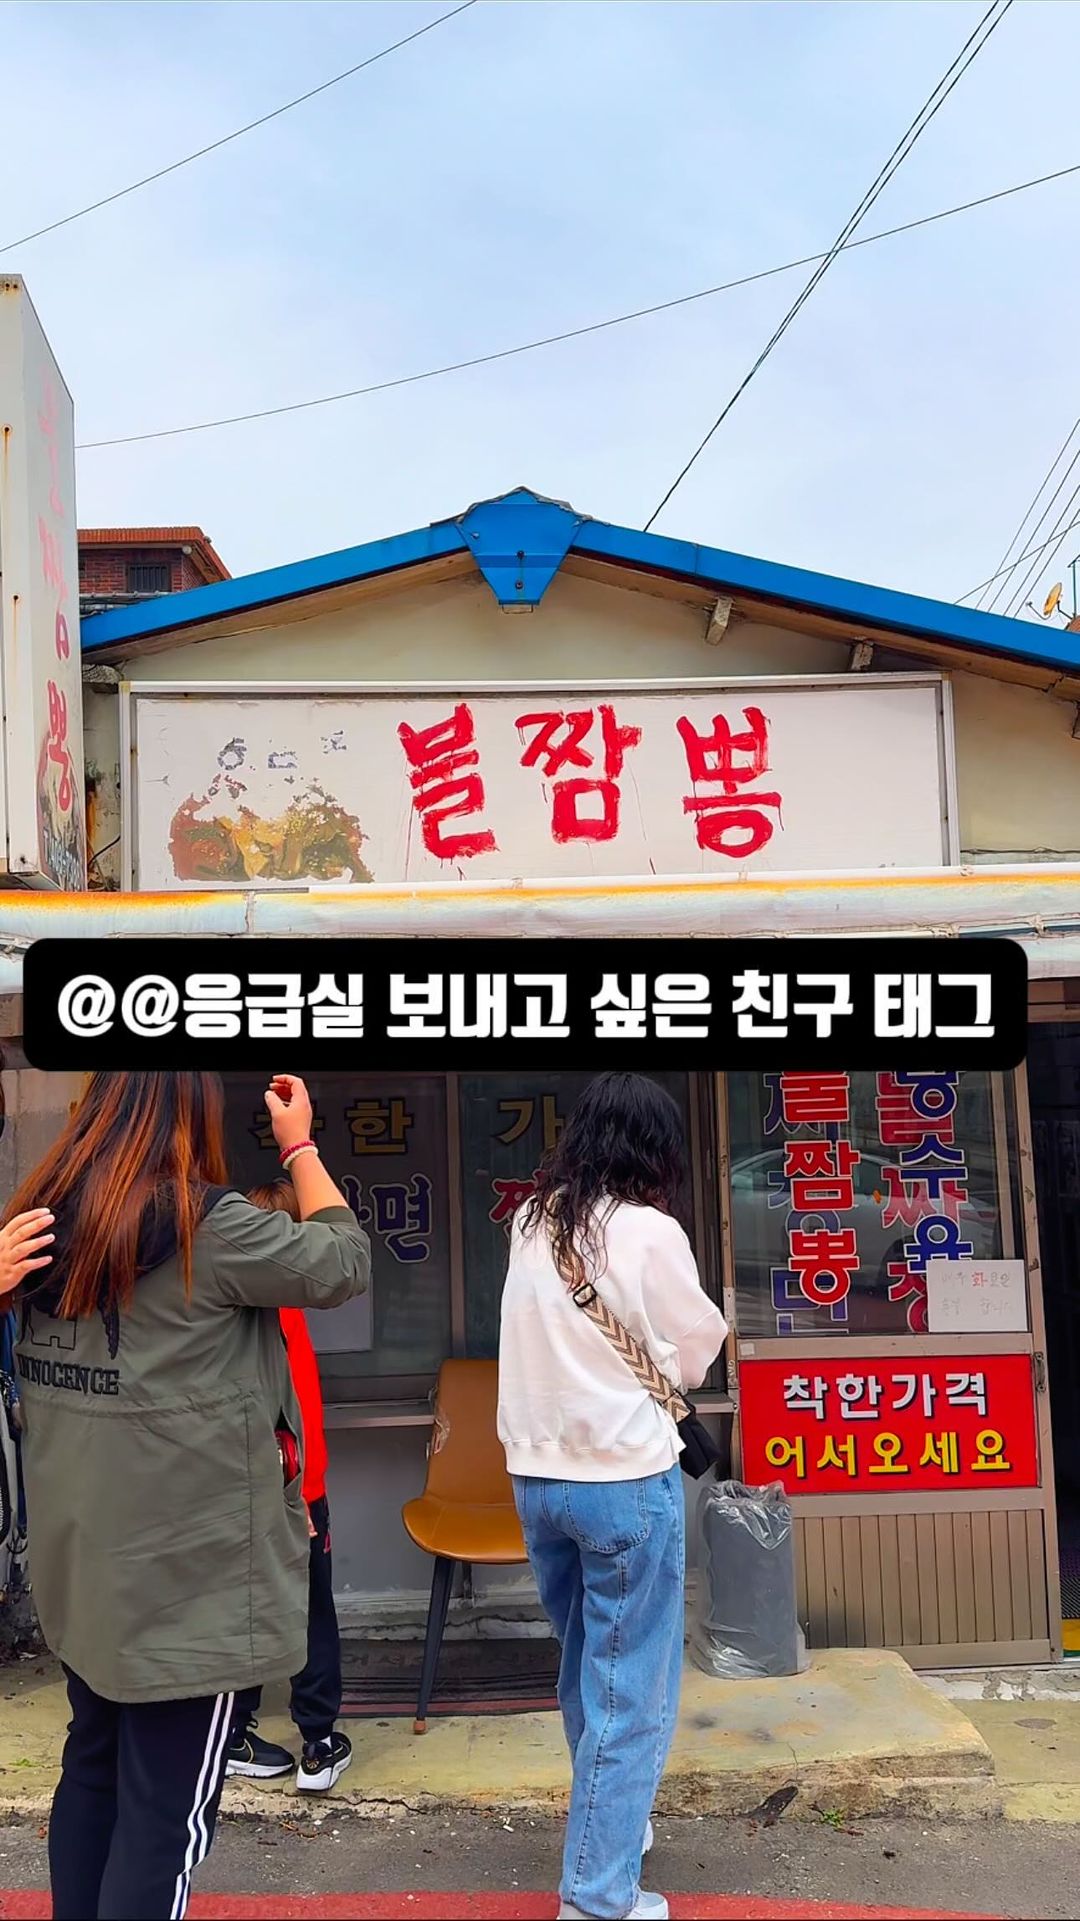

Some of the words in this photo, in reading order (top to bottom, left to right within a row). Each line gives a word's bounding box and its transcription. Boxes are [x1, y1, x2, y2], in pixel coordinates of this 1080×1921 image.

[398, 702, 783, 860] 불짬뽕
[16, 1353, 120, 1396] INNOCENCE
[783, 1372, 986, 1419] 착한가격
[765, 1429, 1010, 1477] 어서오세요
